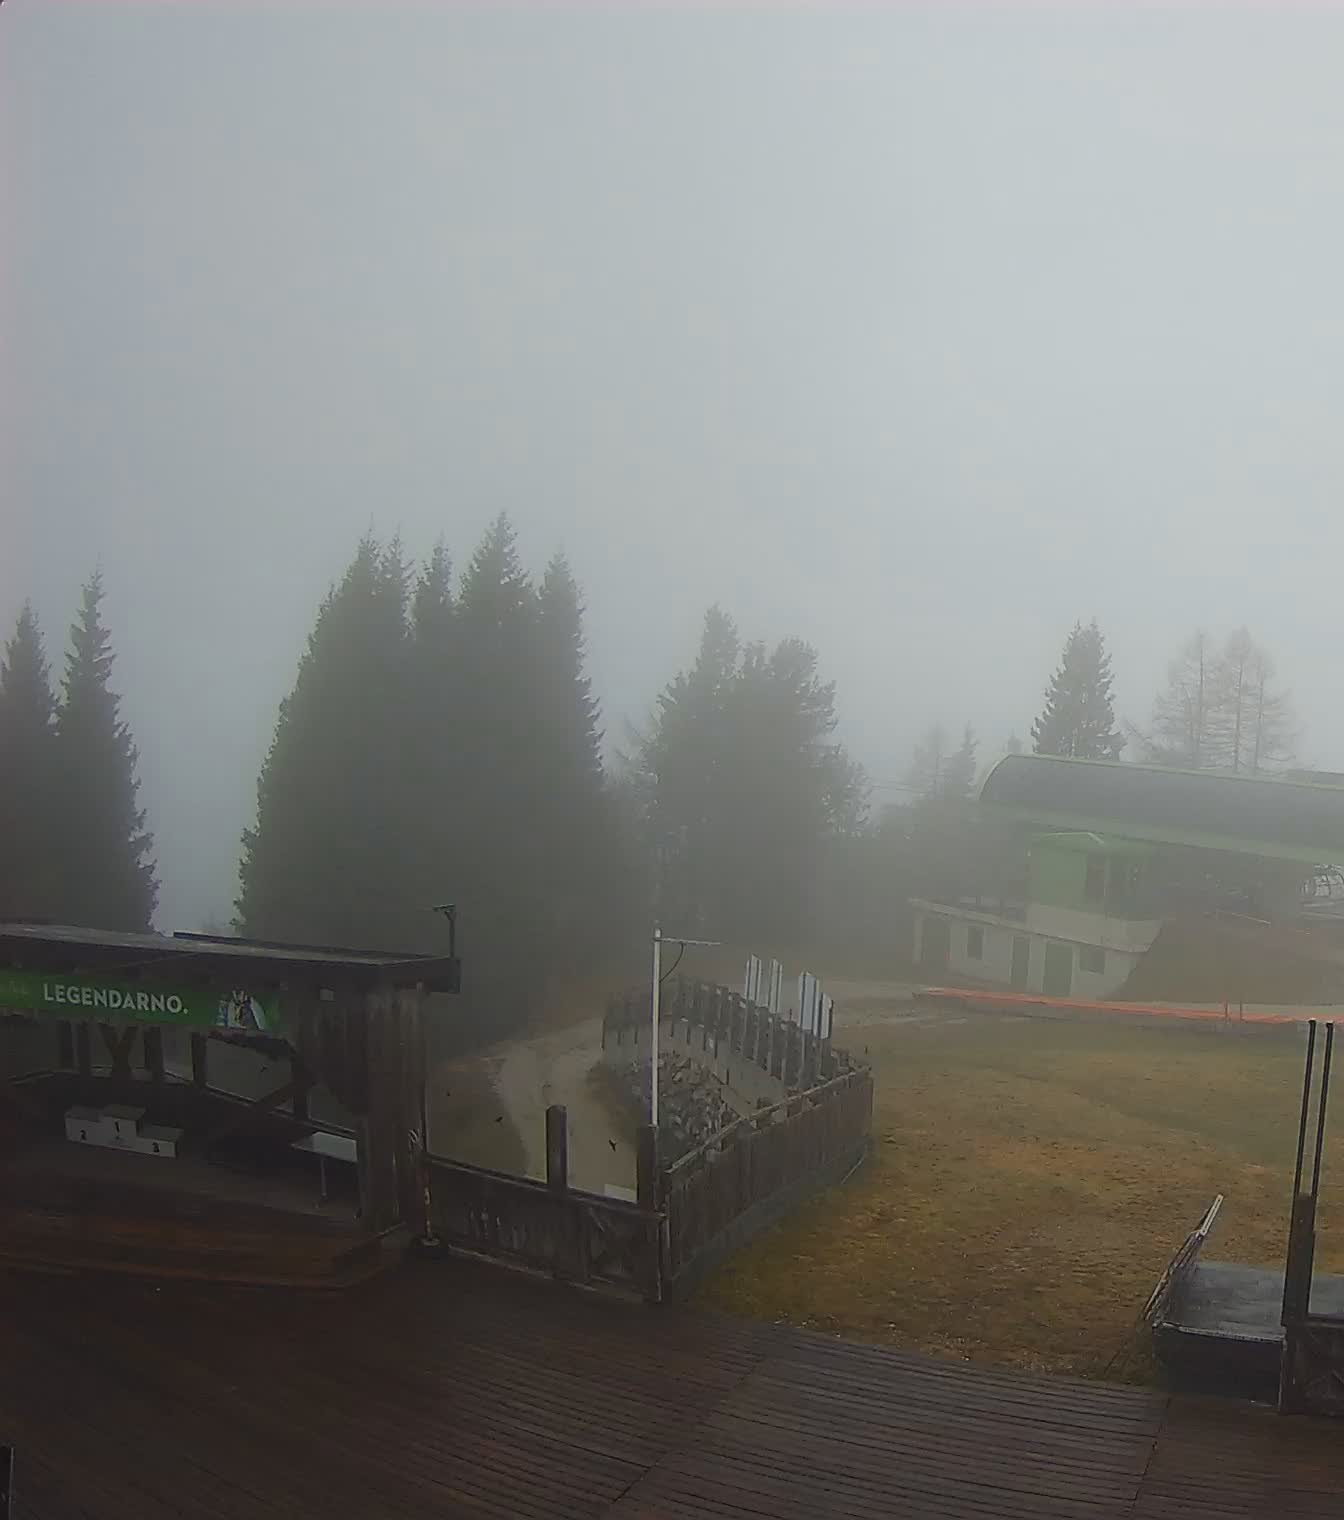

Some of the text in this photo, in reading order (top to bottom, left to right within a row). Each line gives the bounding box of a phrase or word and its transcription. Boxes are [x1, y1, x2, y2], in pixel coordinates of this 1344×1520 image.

[43, 983, 190, 1015] LEGENDARNO.
[79, 1129, 88, 1141] 2
[151, 1141, 161, 1153] 3
